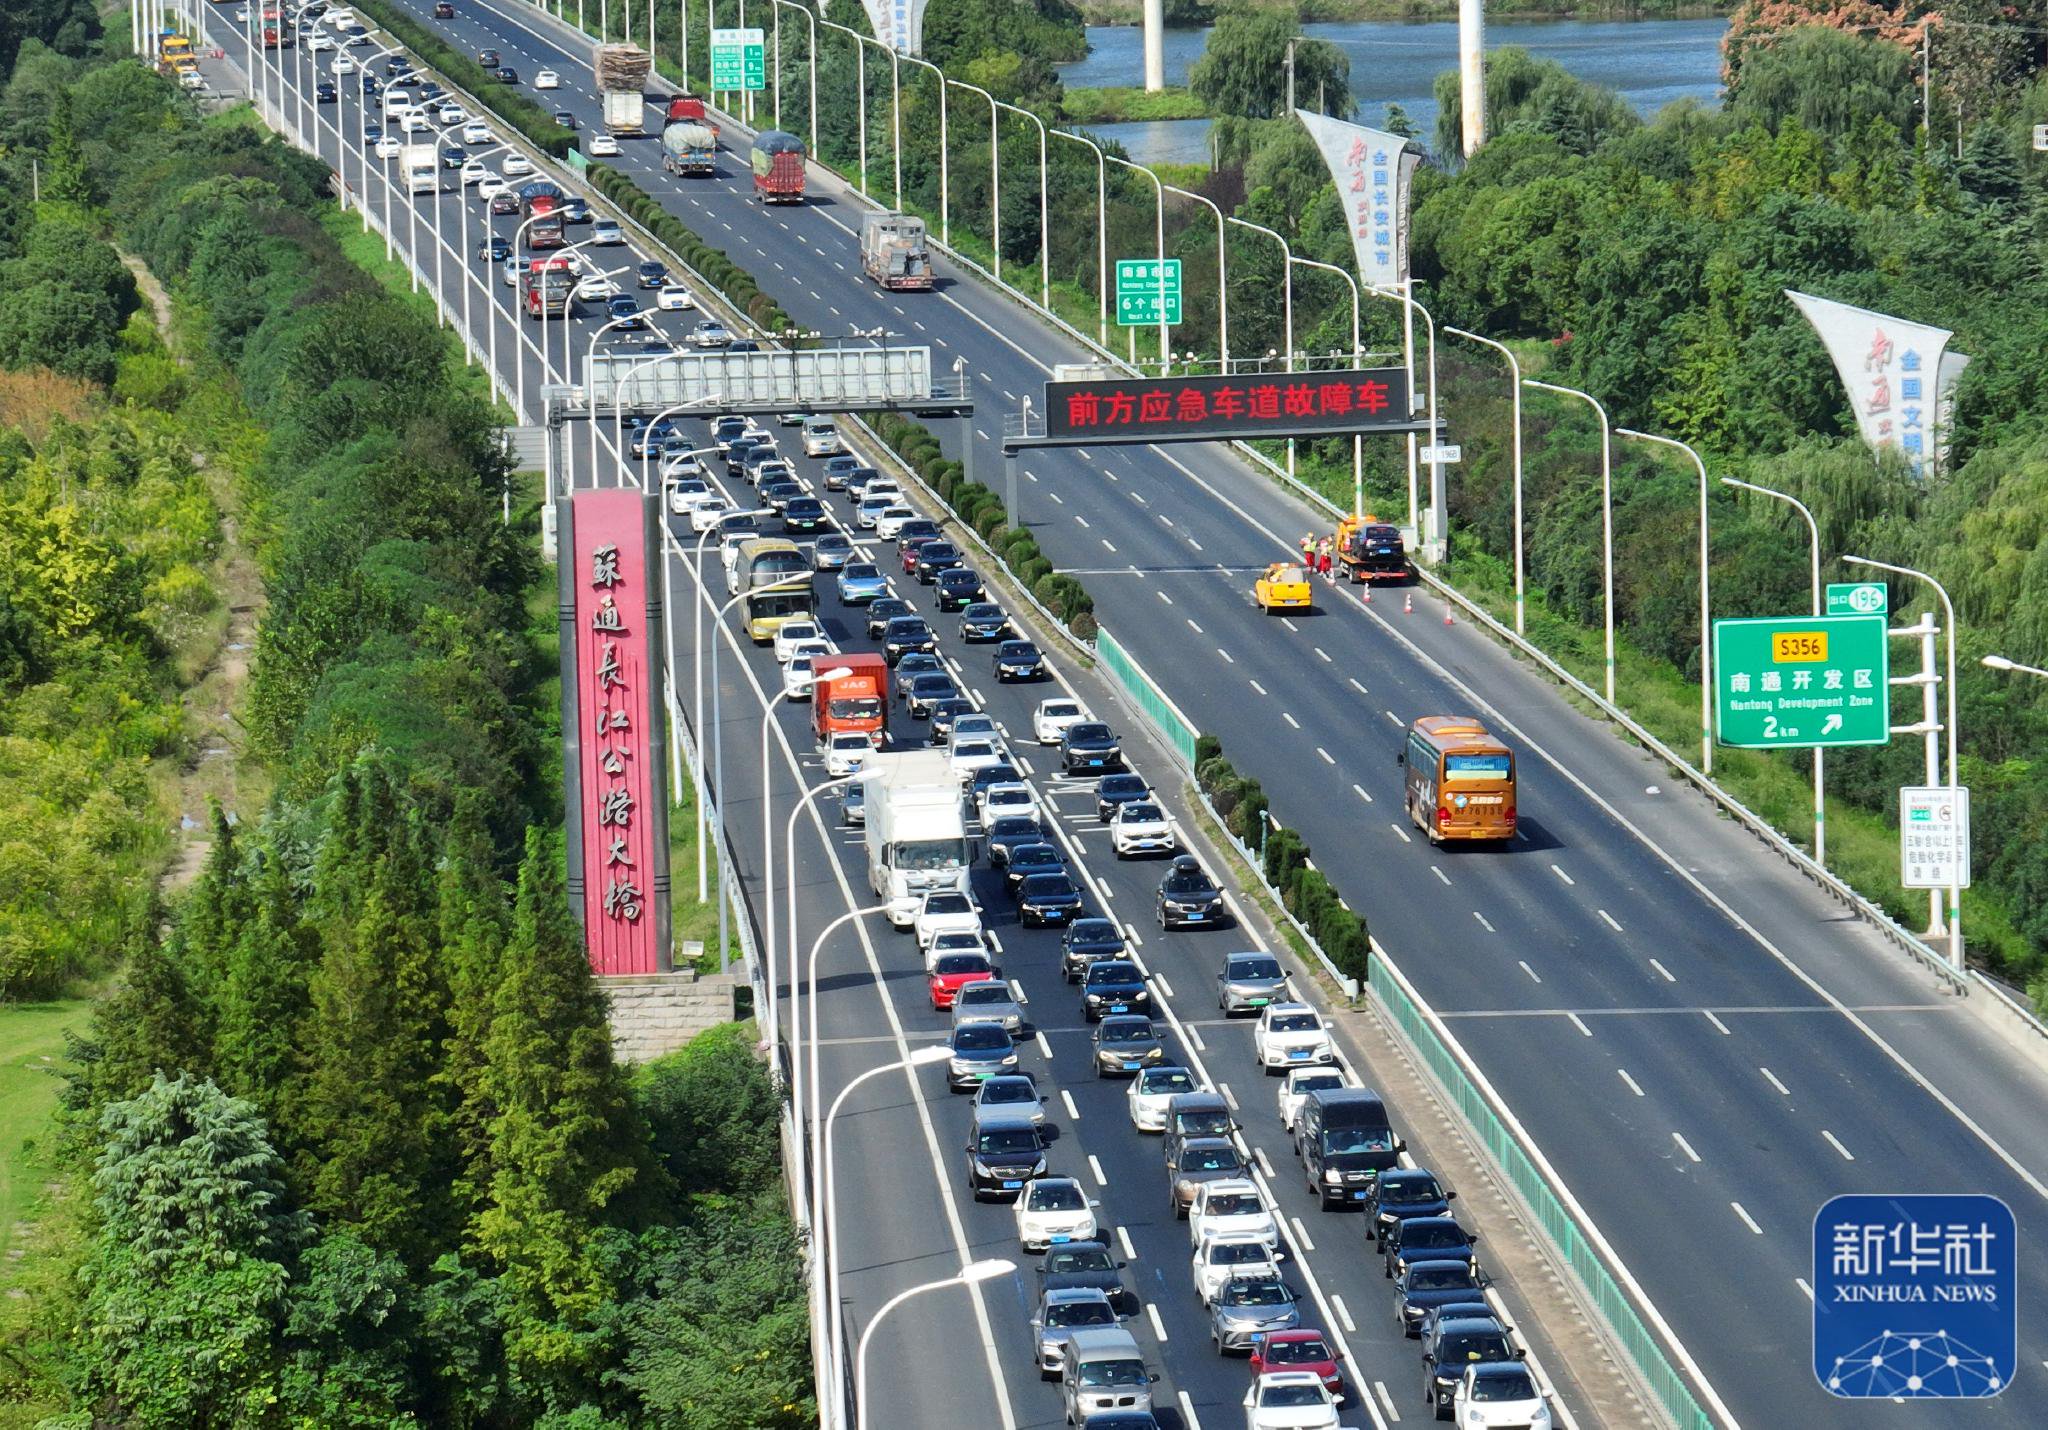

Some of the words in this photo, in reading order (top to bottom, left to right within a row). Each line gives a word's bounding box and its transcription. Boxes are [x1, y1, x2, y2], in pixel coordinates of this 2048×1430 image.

[1067, 380, 1389, 427] 前方应急车道故障车
[1829, 594, 1848, 605] 出口
[1854, 590, 1880, 608] 196
[1781, 638, 1821, 656] S356
[840, 680, 868, 689] JAC
[1730, 669, 1873, 693] 南通开发区
[1730, 699, 1773, 712] Nantong
[1778, 696, 1843, 710] Development
[1849, 695, 1873, 706] Zone
